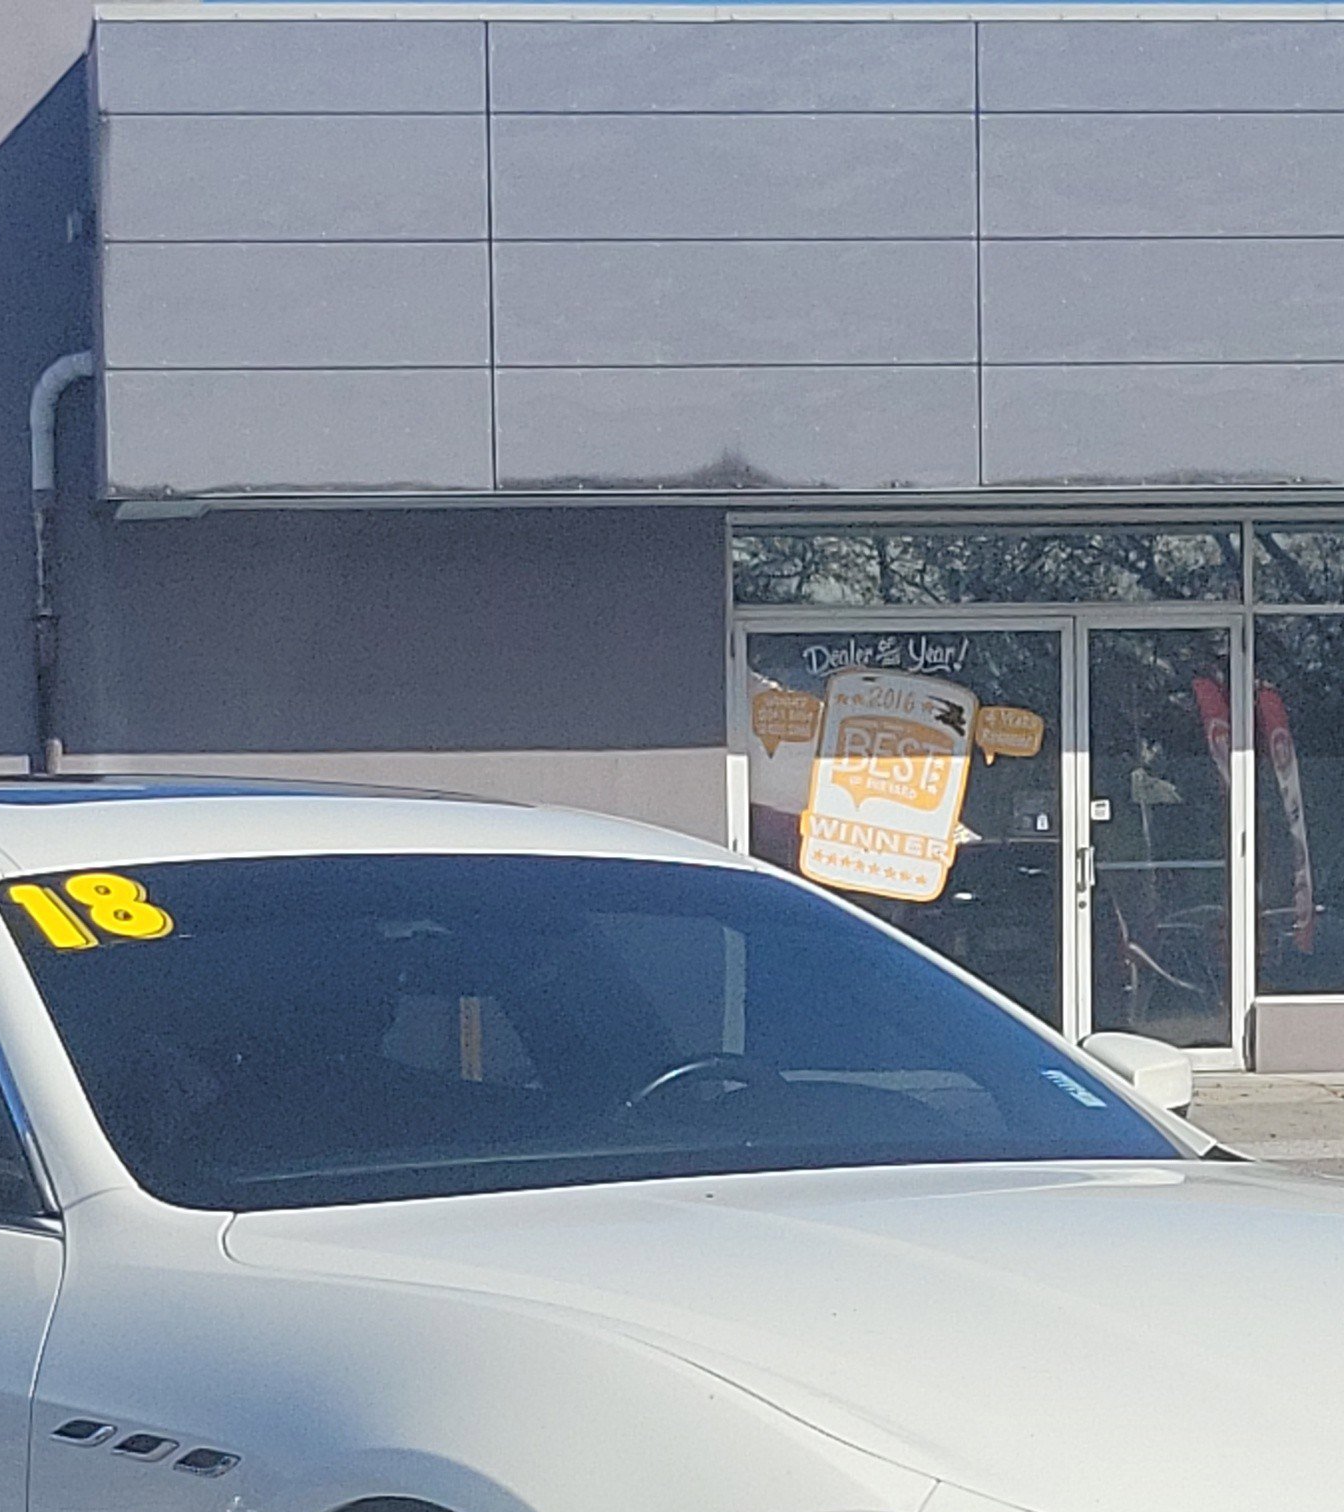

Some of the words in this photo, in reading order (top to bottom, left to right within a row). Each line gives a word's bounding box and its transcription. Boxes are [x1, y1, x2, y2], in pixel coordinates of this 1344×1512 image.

[803, 638, 874, 677] Dealer
[908, 635, 969, 673] Year!
[836, 725, 952, 791] BEST
[808, 814, 949, 860] WINNER
[9, 872, 175, 950] 18
